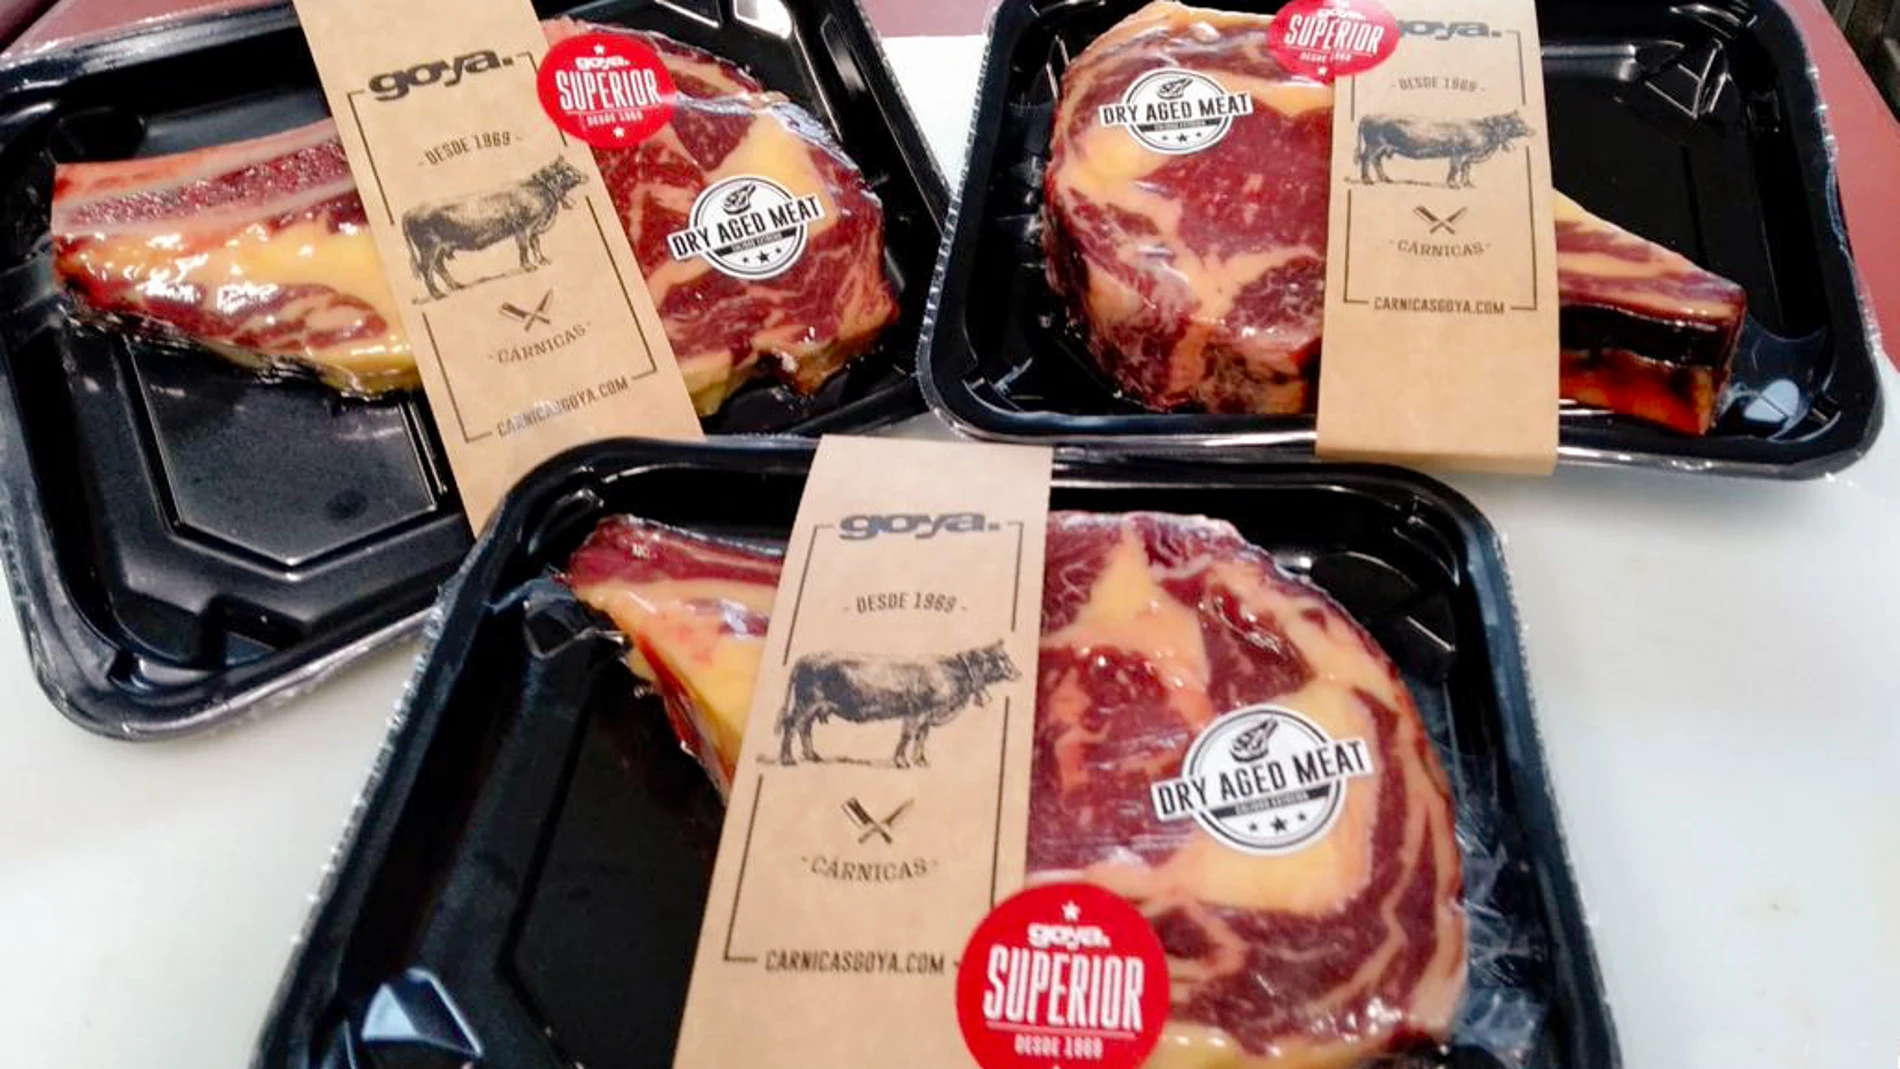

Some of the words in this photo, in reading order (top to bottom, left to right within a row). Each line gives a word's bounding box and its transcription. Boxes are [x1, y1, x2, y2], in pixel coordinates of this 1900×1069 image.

[1284, 14, 1384, 54] SUPERIOR
[1397, 20, 1501, 40] oya.
[369, 51, 514, 101] goya.
[555, 68, 662, 111] SUPERIOR
[1399, 76, 1440, 91] DESDE
[1103, 104, 1138, 125] DRY
[1146, 100, 1192, 122] AGED
[1198, 92, 1249, 117] MEAT
[424, 137, 470, 165] DESDE
[672, 227, 711, 257] DRY
[717, 212, 766, 243] AGED
[768, 196, 820, 228] MEAT
[1374, 296, 1505, 315] CARNICASGOYA.COM
[839, 511, 1000, 540] goya.
[856, 592, 908, 613] DESDE
[1157, 775, 1208, 815] DRY
[1219, 761, 1286, 801] AGED
[1292, 740, 1365, 785] MEAT
[765, 949, 945, 974] CARNICASGOYA.COM
[983, 944, 1144, 1032] SUPERIOR
